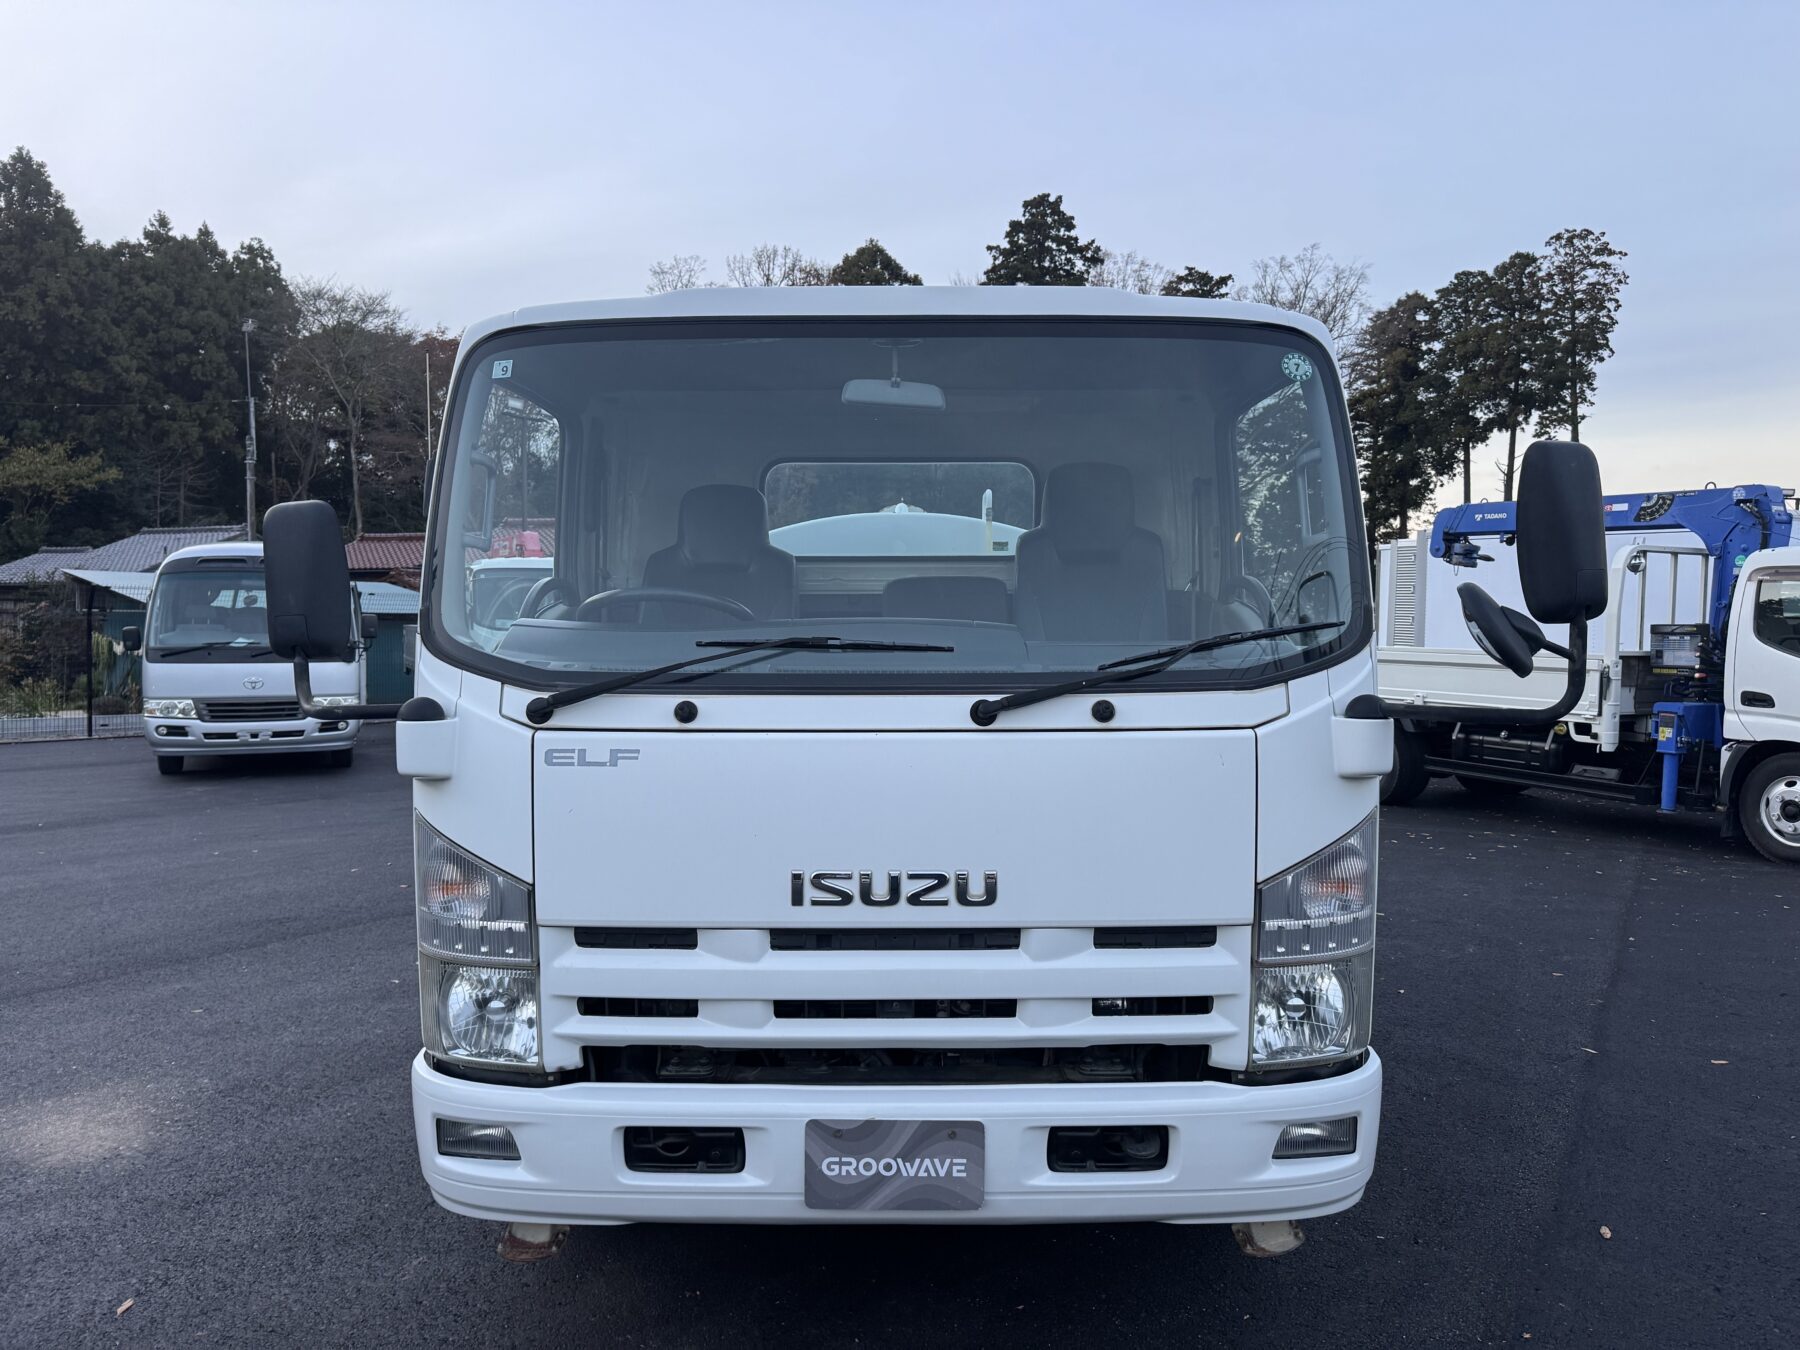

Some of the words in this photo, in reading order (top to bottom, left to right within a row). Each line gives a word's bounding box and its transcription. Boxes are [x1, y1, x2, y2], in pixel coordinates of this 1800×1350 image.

[1293, 363, 1300, 372] 7
[544, 748, 640, 767] ELF
[791, 871, 997, 907] ISUZU
[821, 1156, 967, 1177] GROOWAVE
